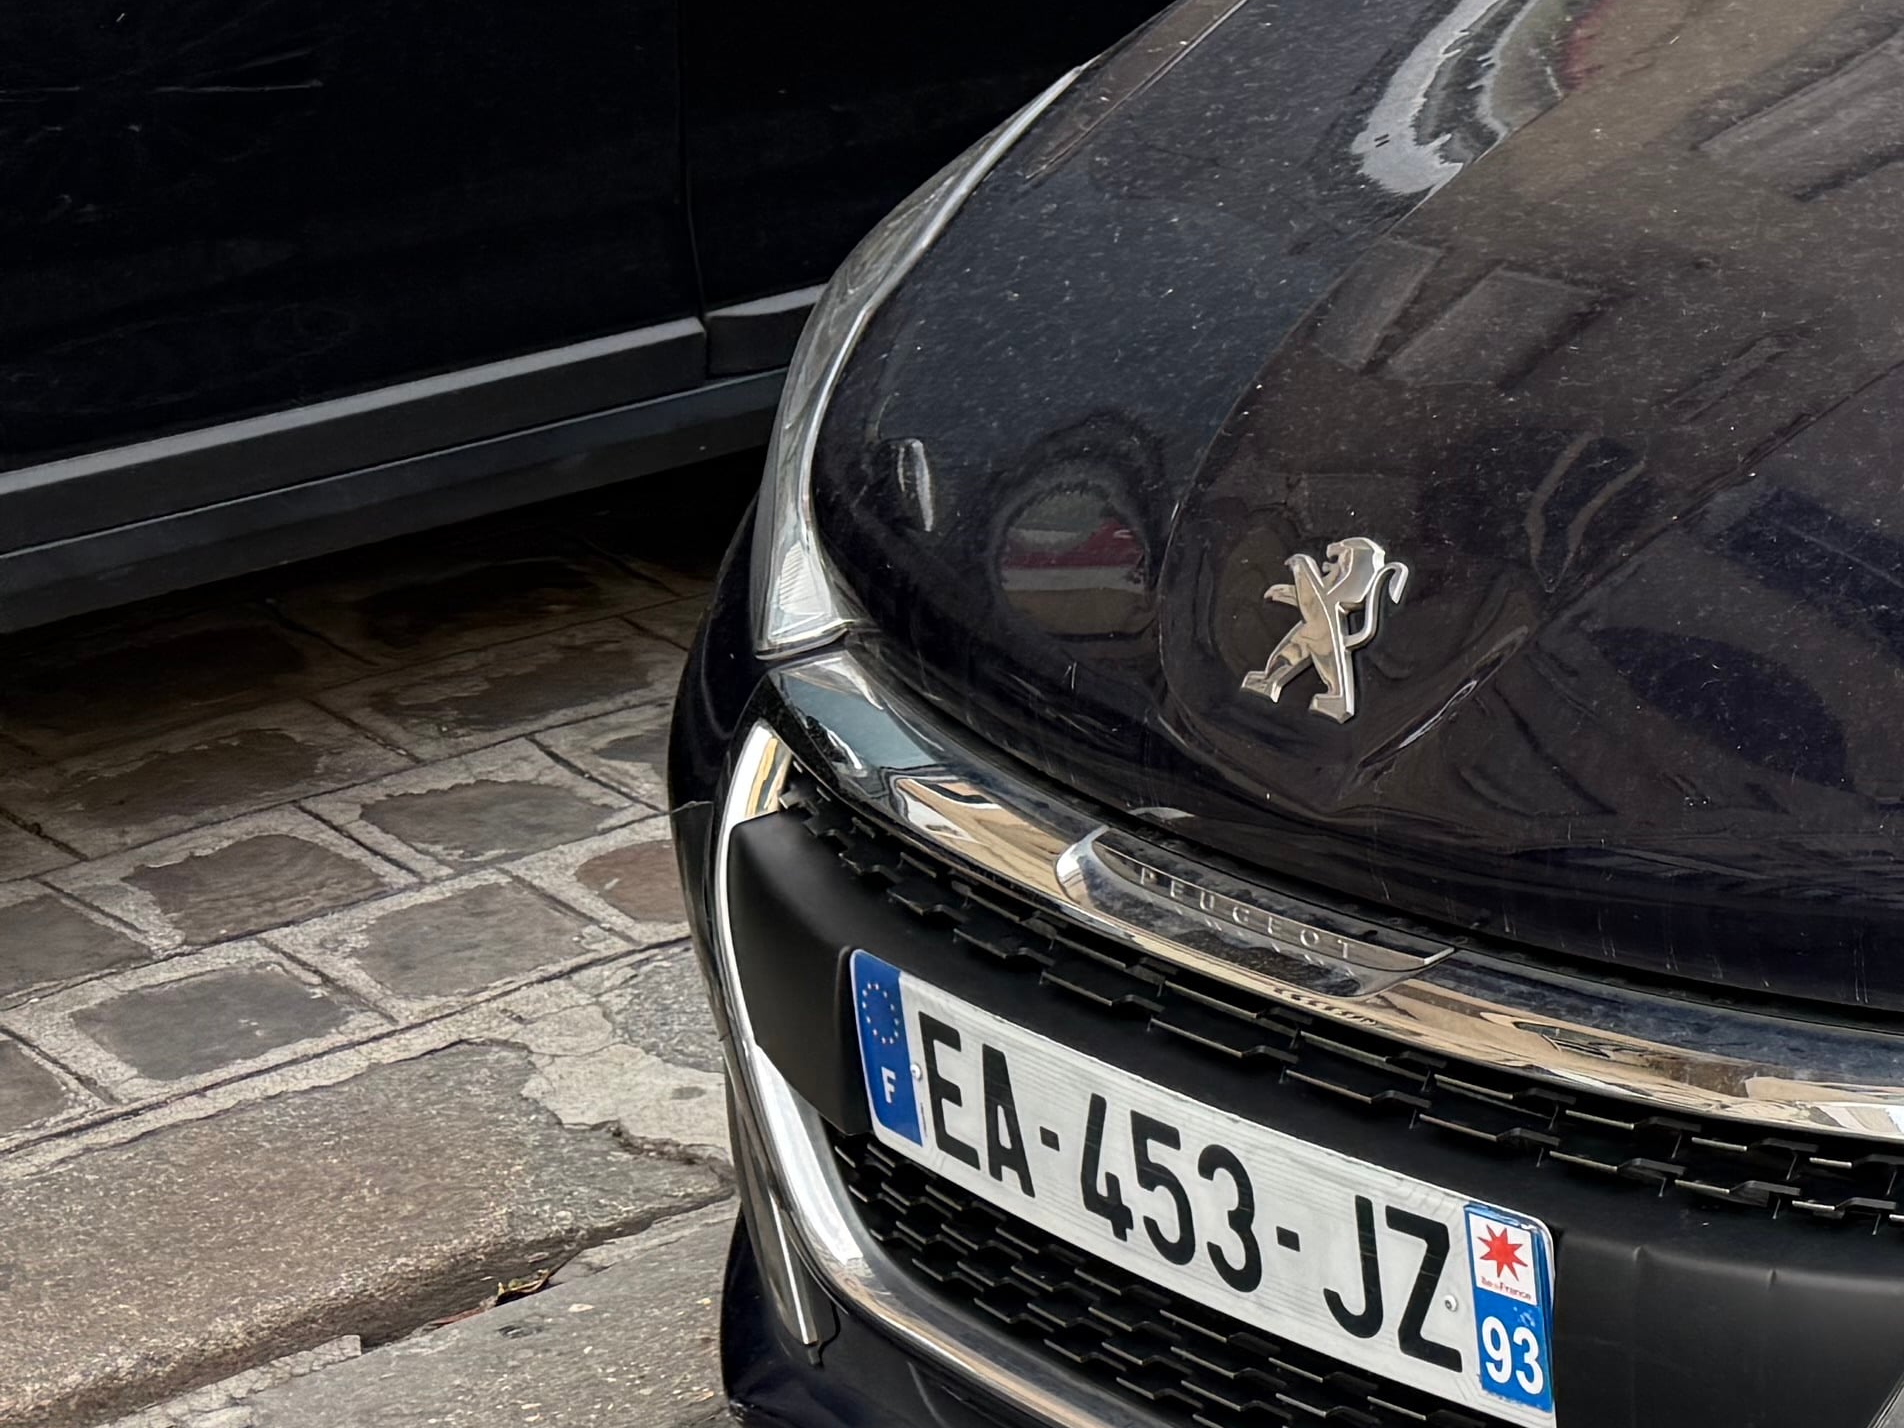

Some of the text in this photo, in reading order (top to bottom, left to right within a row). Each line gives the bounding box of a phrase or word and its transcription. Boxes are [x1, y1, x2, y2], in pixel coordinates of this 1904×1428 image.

[1140, 866, 1350, 959] PEUGEOT
[880, 1065, 896, 1105] F
[918, 1011, 1462, 1372] EA-453-JZ
[1481, 1315, 1546, 1395] 93
